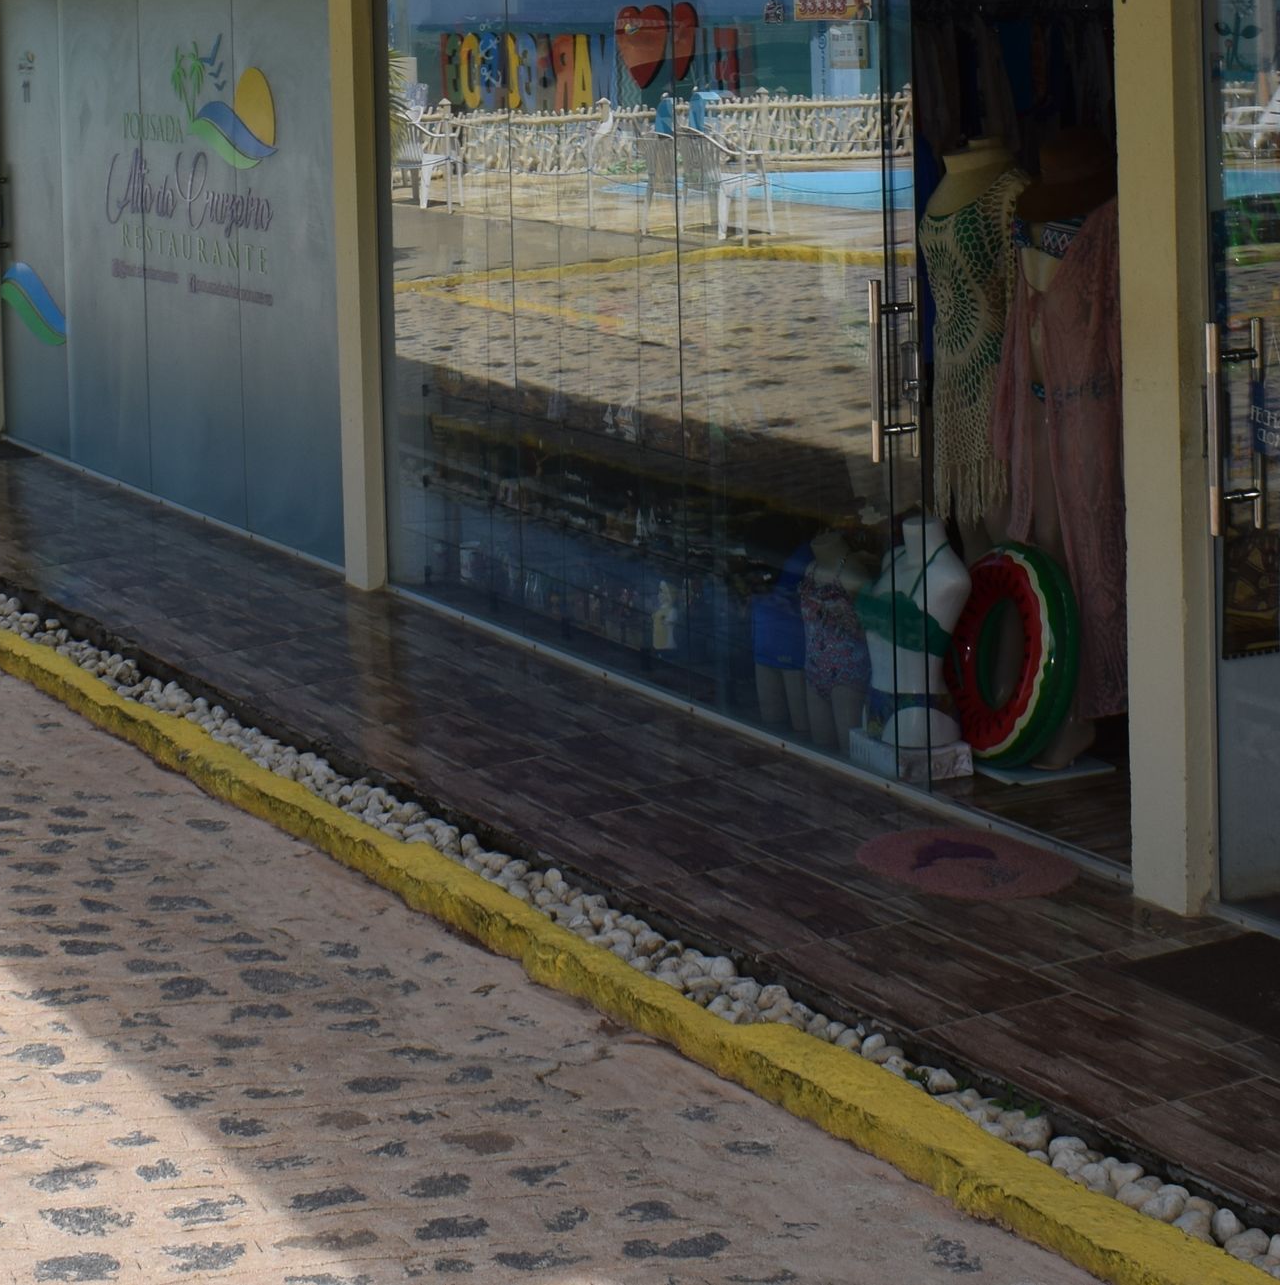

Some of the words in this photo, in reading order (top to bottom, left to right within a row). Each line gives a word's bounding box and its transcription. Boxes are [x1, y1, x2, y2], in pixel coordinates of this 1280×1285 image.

[122, 112, 185, 145] POUSADA
[106, 147, 155, 225] Alto
[155, 172, 177, 220] do
[175, 150, 274, 239] Cruzeiro
[121, 222, 269, 276] RESTAURANTE
